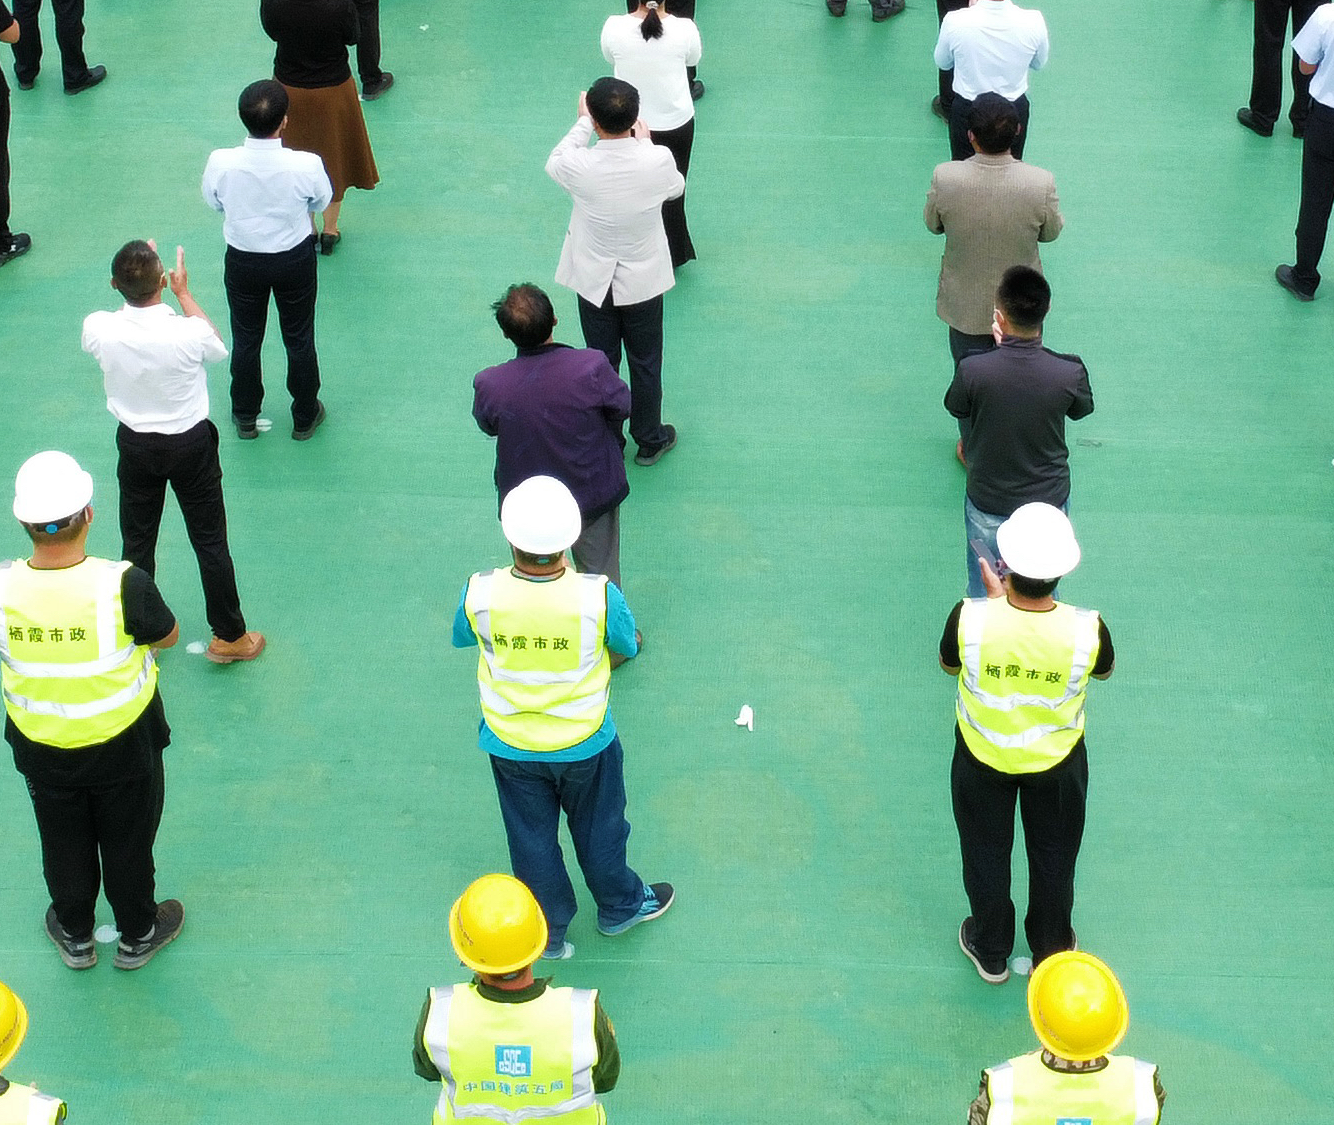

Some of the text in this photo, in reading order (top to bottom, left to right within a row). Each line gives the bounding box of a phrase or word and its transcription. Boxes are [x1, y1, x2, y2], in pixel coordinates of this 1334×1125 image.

[9, 626, 86, 643] 栖霞市政
[494, 633, 569, 651] 栖霞市政
[986, 663, 1062, 684] 栖霞市政
[463, 1080, 565, 1097] 中国建筑五局
